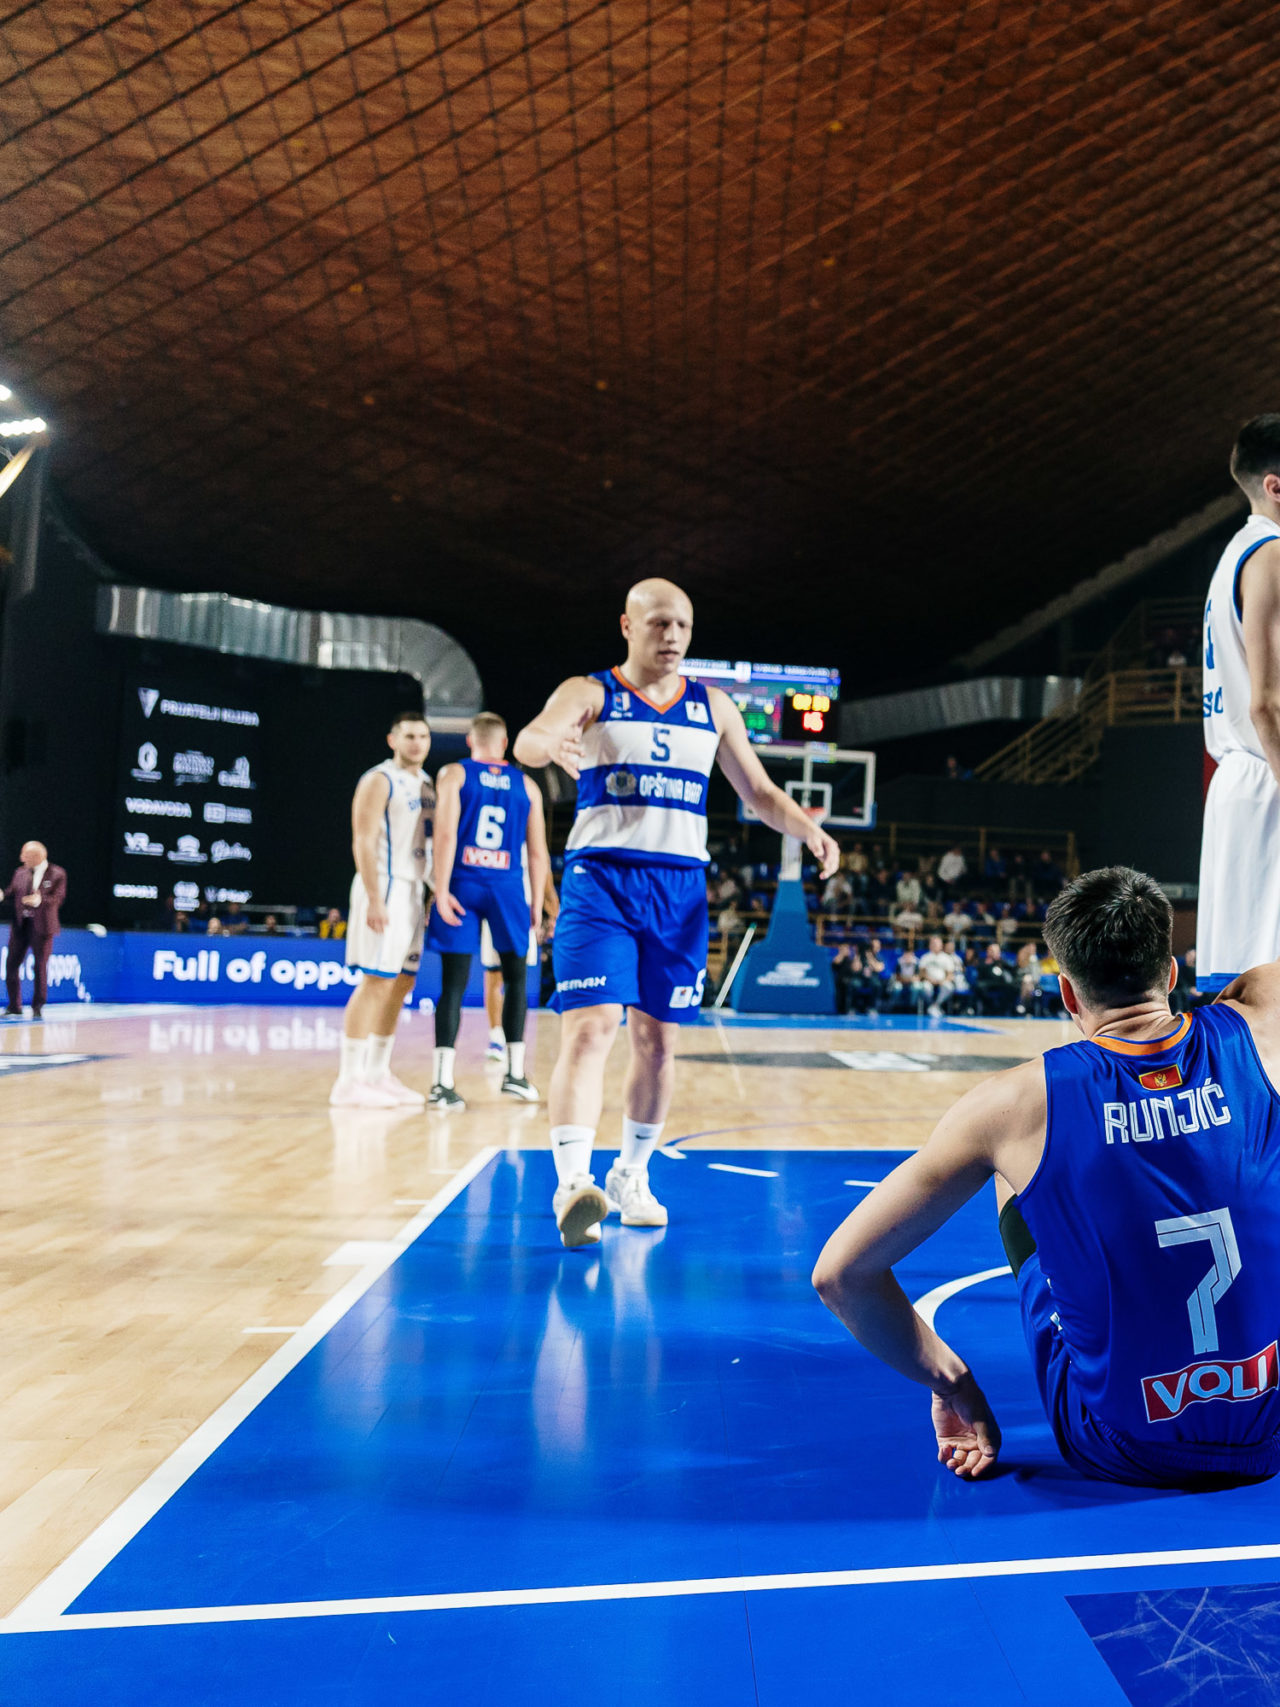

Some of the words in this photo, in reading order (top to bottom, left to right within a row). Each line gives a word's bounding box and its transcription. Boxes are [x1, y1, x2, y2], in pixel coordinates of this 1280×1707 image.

[650, 728, 670, 762] 5
[475, 804, 506, 850] 6
[153, 950, 220, 982] Full
[226, 951, 267, 983] of
[1103, 1077, 1232, 1144] RUNJIĆ
[1154, 1206, 1243, 1356] 7
[1152, 1354, 1268, 1413] VOLI
